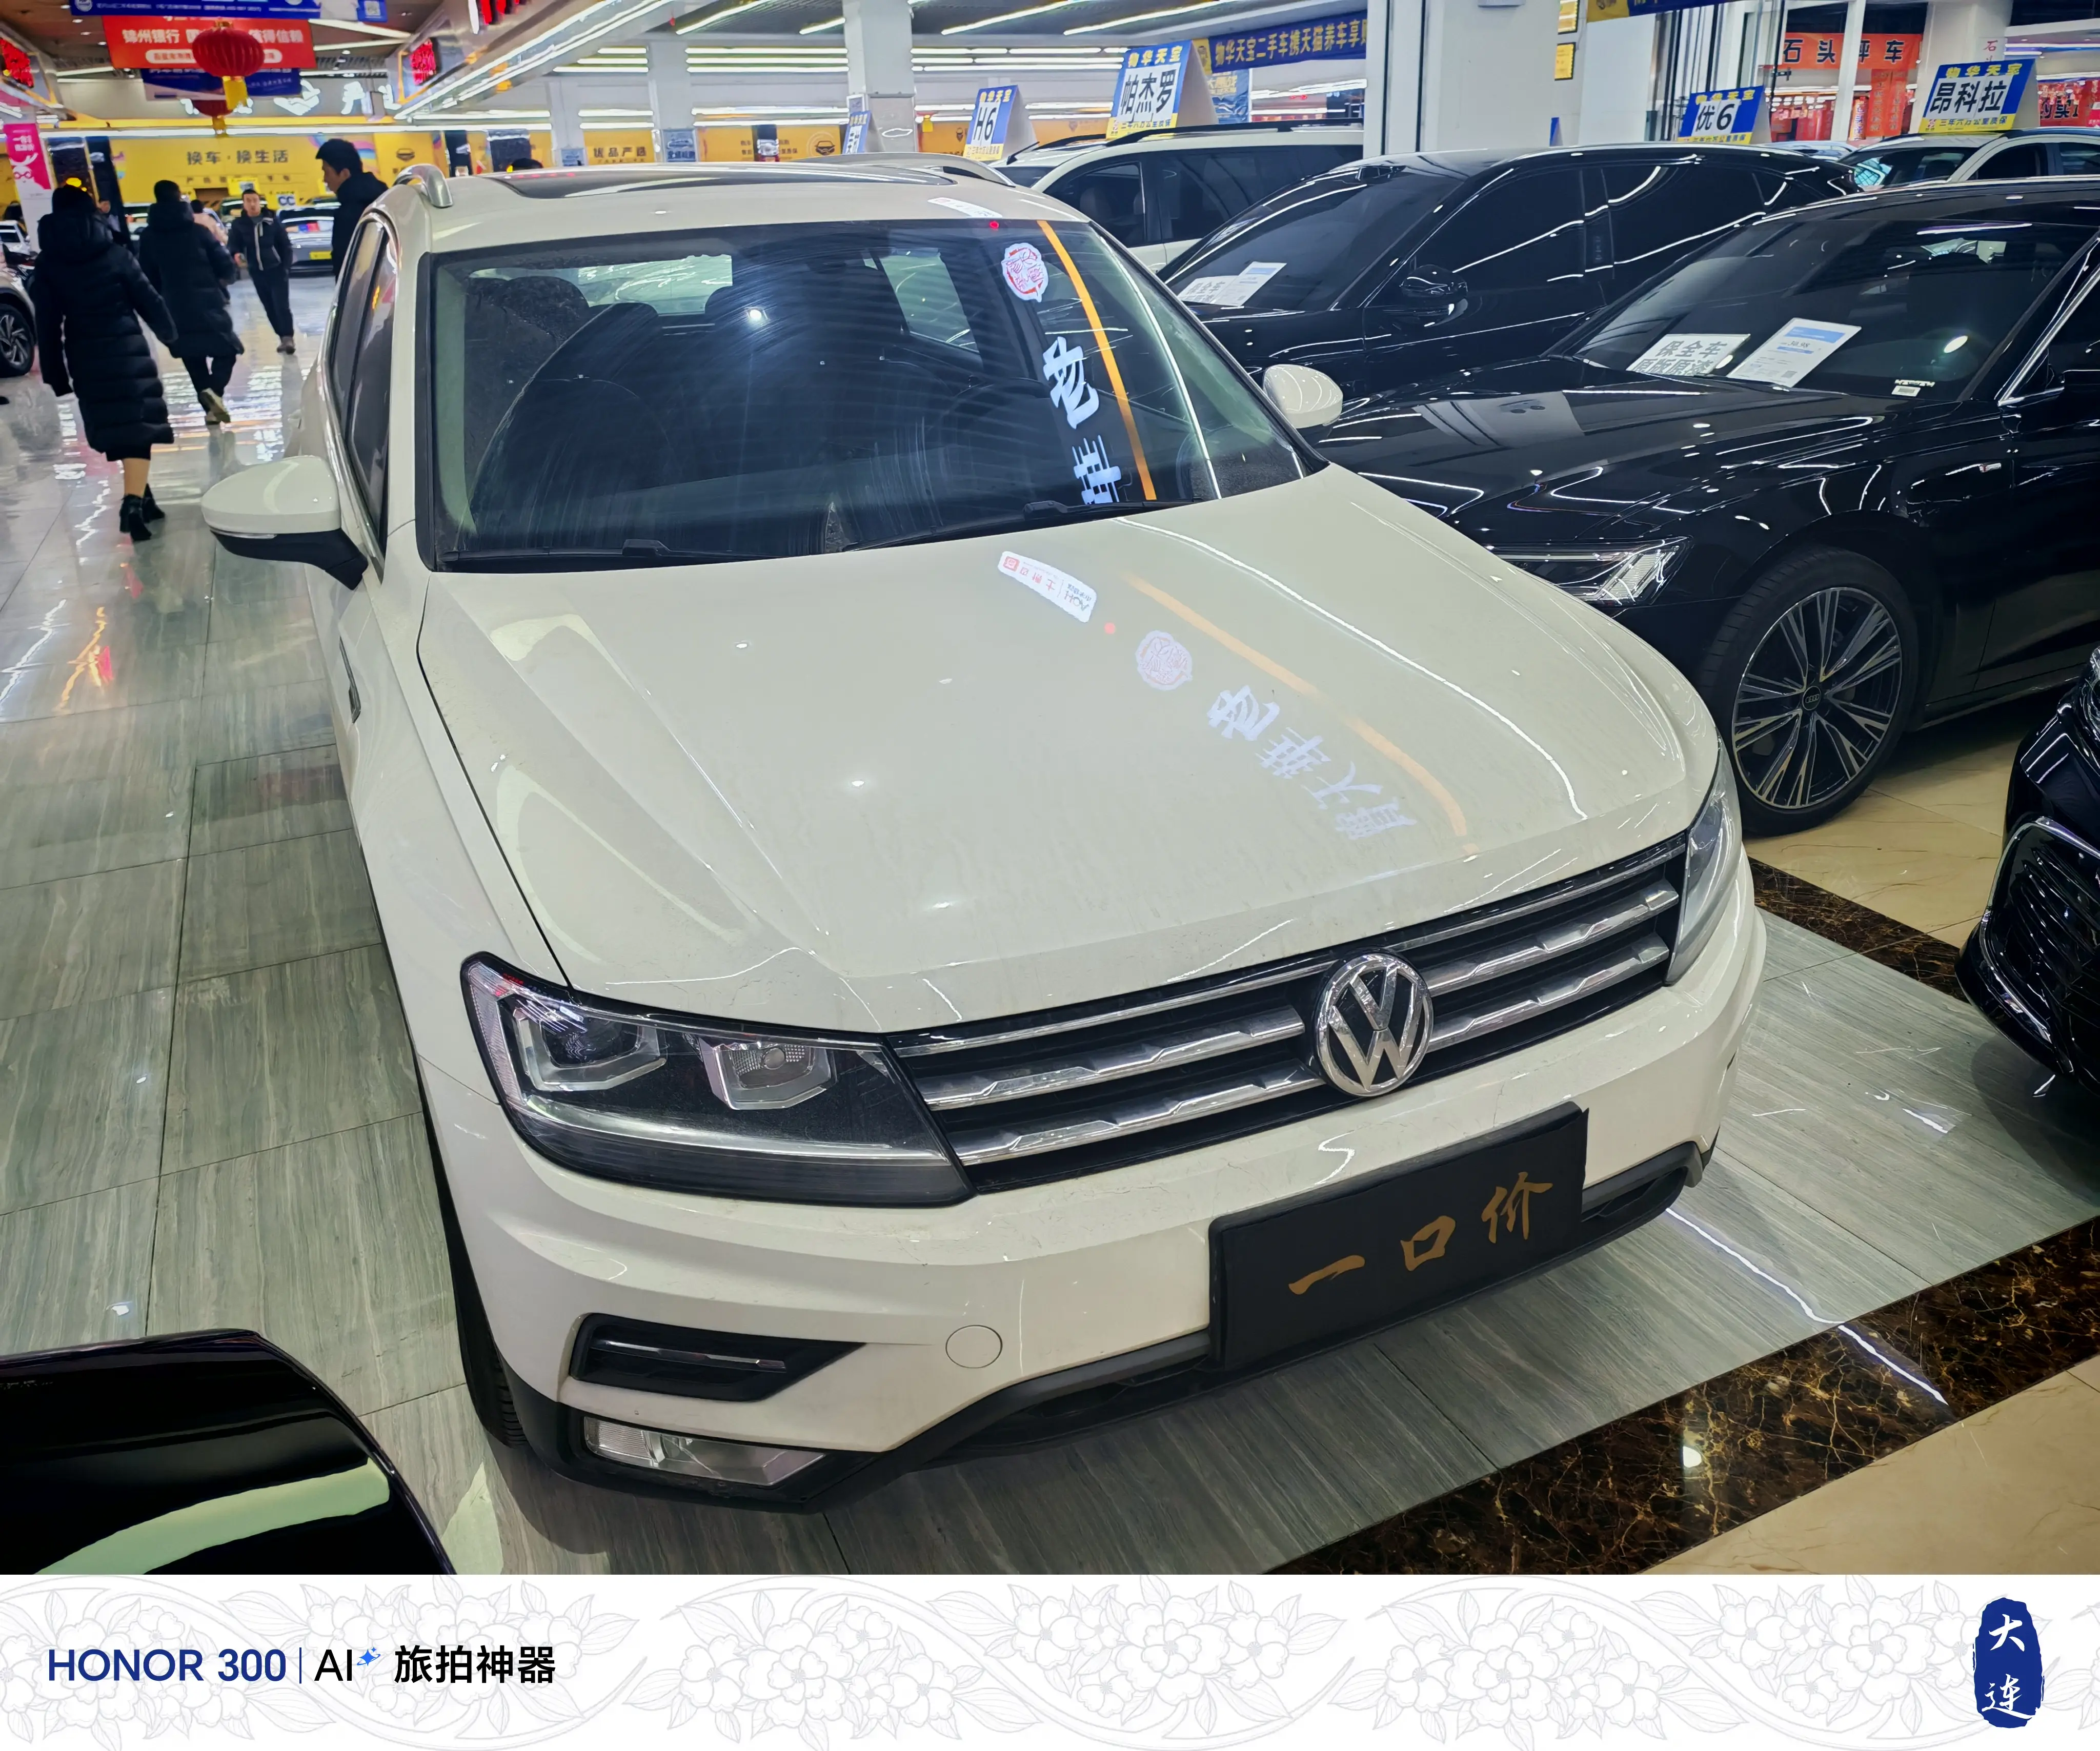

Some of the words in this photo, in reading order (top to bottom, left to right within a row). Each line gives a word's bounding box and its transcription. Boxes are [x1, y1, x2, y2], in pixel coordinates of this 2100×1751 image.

[1128, 46, 1183, 68] 物华天宝
[1946, 64, 2023, 78] 物华天宝
[1121, 69, 1177, 114] 帕杰罗
[1929, 80, 2008, 114] 昂科拉
[973, 107, 997, 141] H6
[1695, 103, 1735, 132] 优6
[1939, 116, 2008, 127] 三年六万公里质保
[1655, 340, 1728, 358] 保全车
[1288, 1171, 1553, 1295] 一口价
